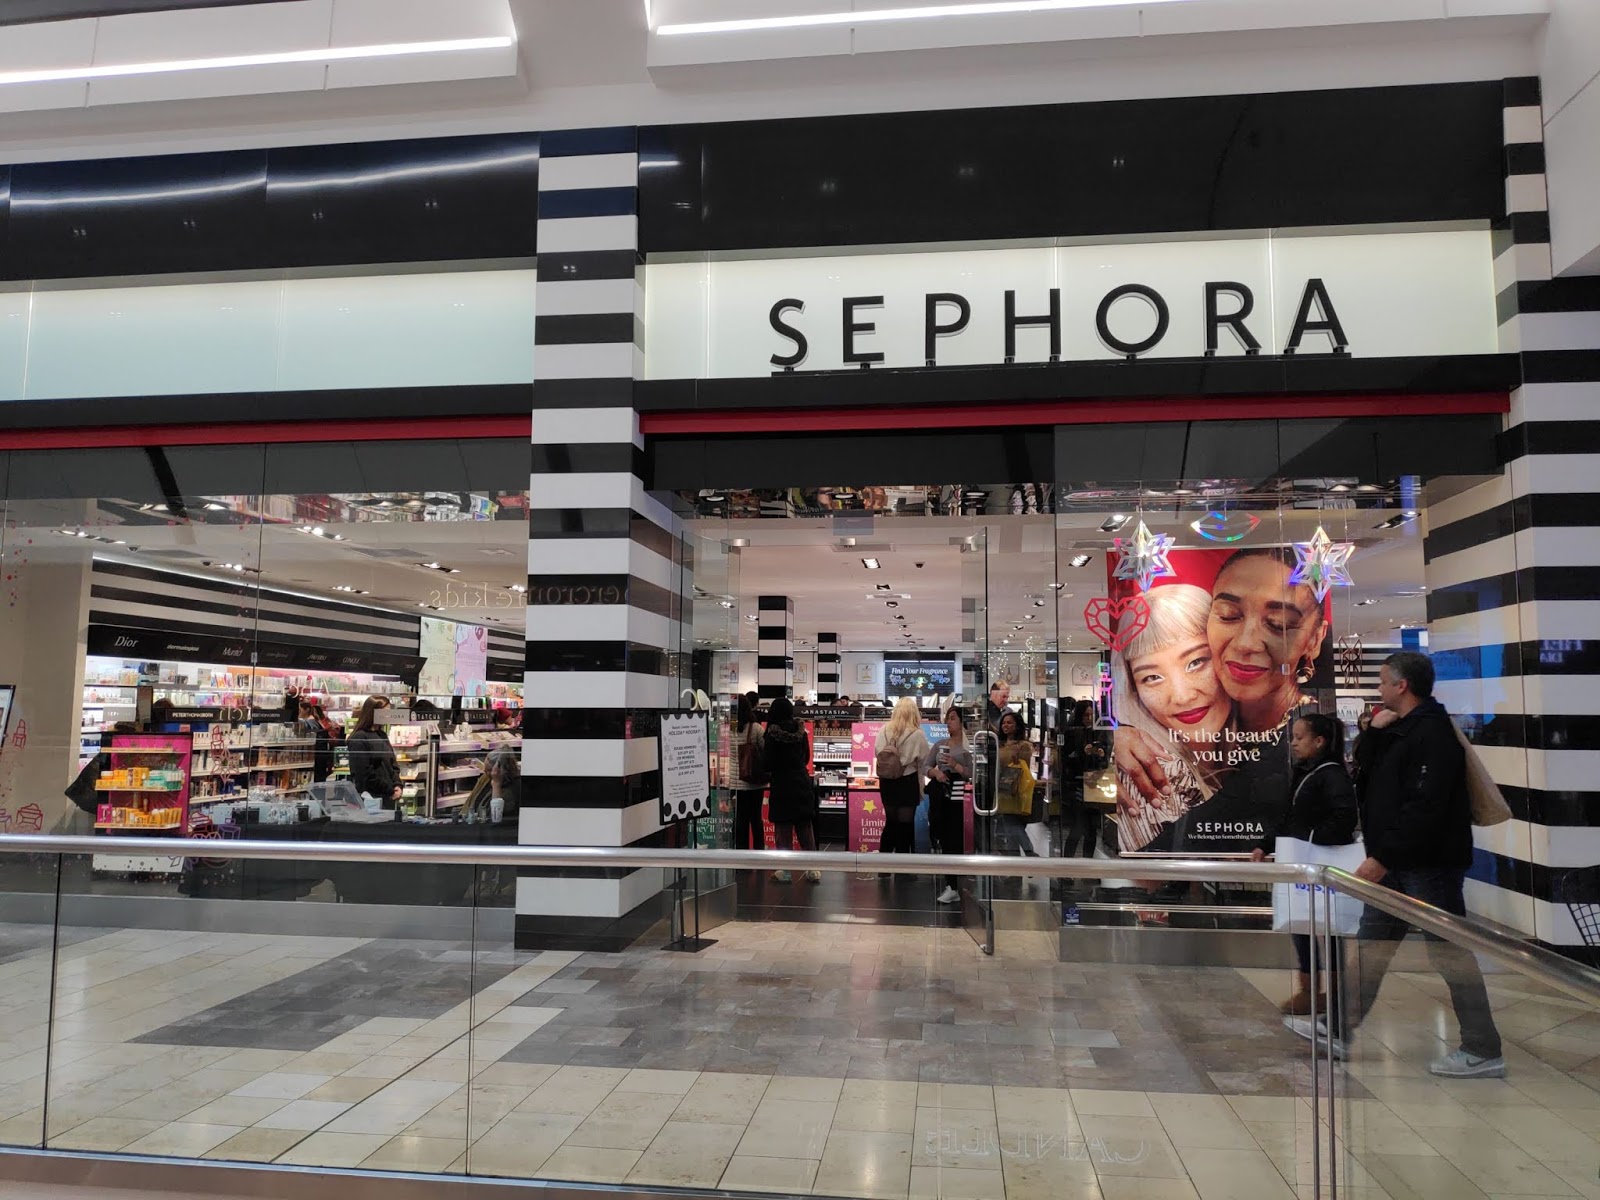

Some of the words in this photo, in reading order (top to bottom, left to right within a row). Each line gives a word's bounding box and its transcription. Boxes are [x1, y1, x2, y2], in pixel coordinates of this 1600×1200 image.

[769, 278, 1349, 368] SEPHORA
[114, 635, 138, 648] Dior
[891, 667, 905, 675] Find
[905, 667, 919, 675] Your
[920, 667, 949, 676] Fragrance
[1168, 728, 1191, 743] It's
[1194, 728, 1221, 743] the
[1224, 727, 1283, 746] beauty
[1193, 749, 1223, 765] you
[1227, 747, 1261, 766] give
[1196, 822, 1264, 833] SEPHORA
